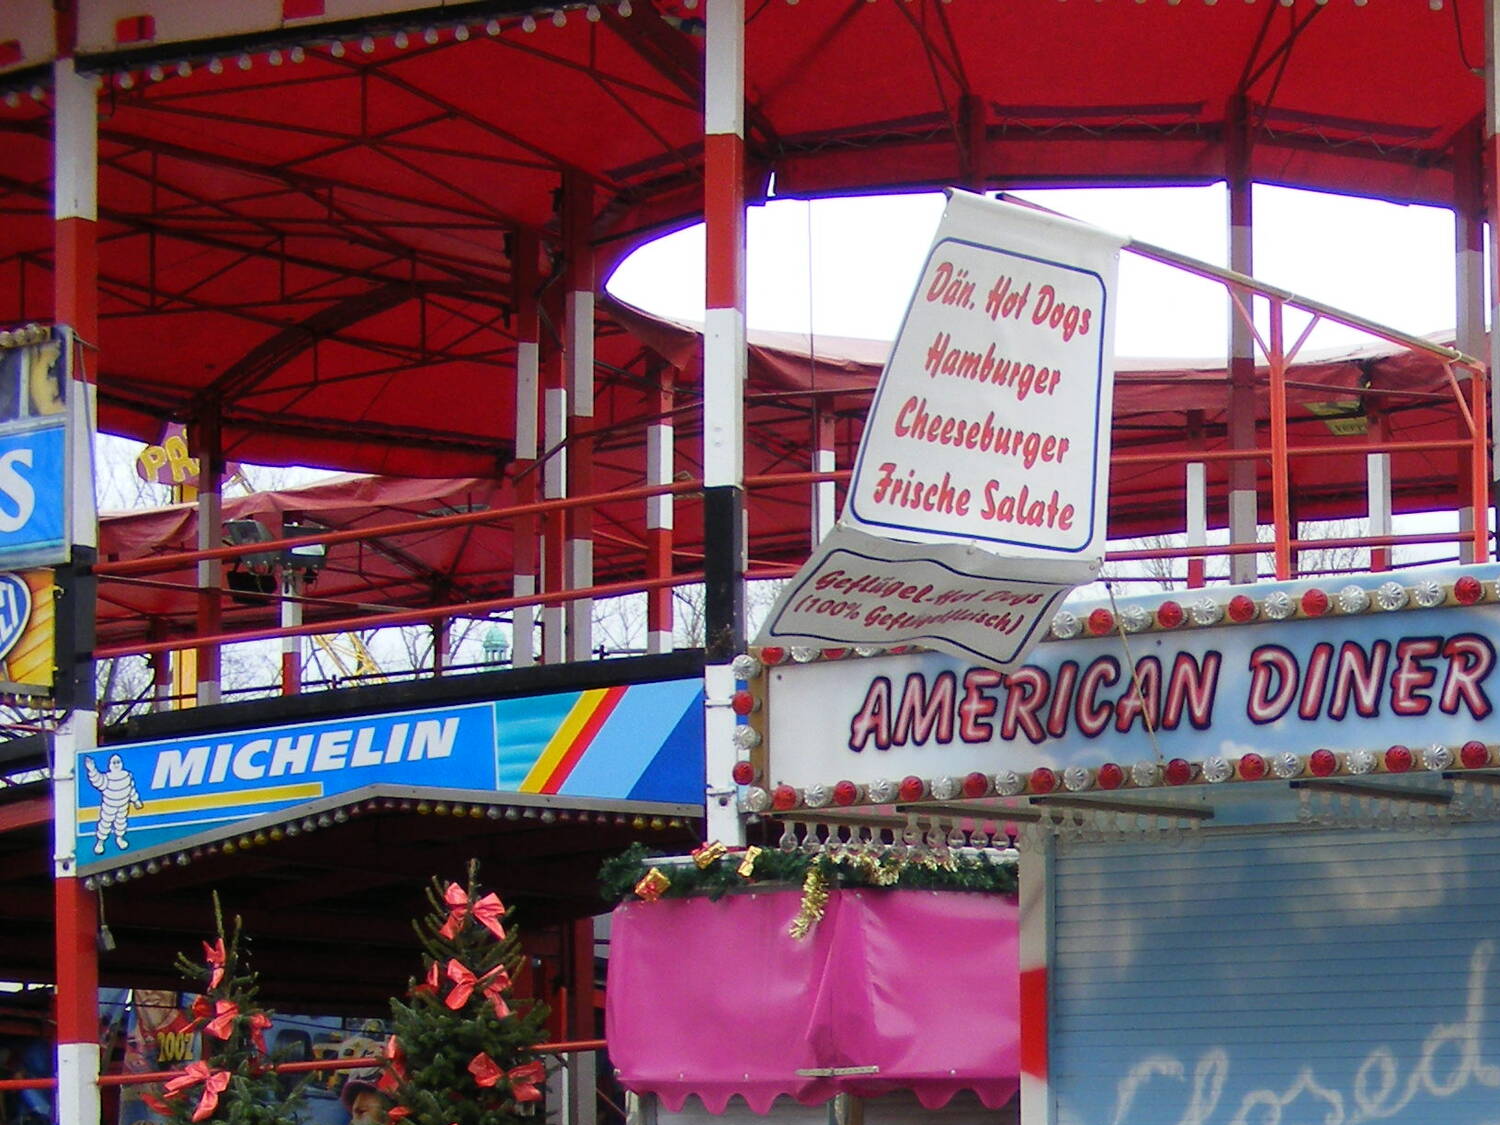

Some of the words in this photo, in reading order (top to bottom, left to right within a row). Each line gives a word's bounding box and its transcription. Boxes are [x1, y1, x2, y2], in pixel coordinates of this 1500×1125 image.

[926, 260, 975, 311] Dän.
[985, 275, 1033, 322] Hot
[1032, 284, 1092, 343] Dogs
[924, 331, 1061, 401] Hamburger
[894, 396, 1070, 470] Cheeseburger
[873, 461, 970, 517] Frische
[980, 479, 1075, 531] Salate
[793, 594, 860, 620] (100%
[848, 649, 1223, 752] AMERICAN
[1245, 632, 1497, 728] DINER
[150, 717, 460, 791] MICHELIN
